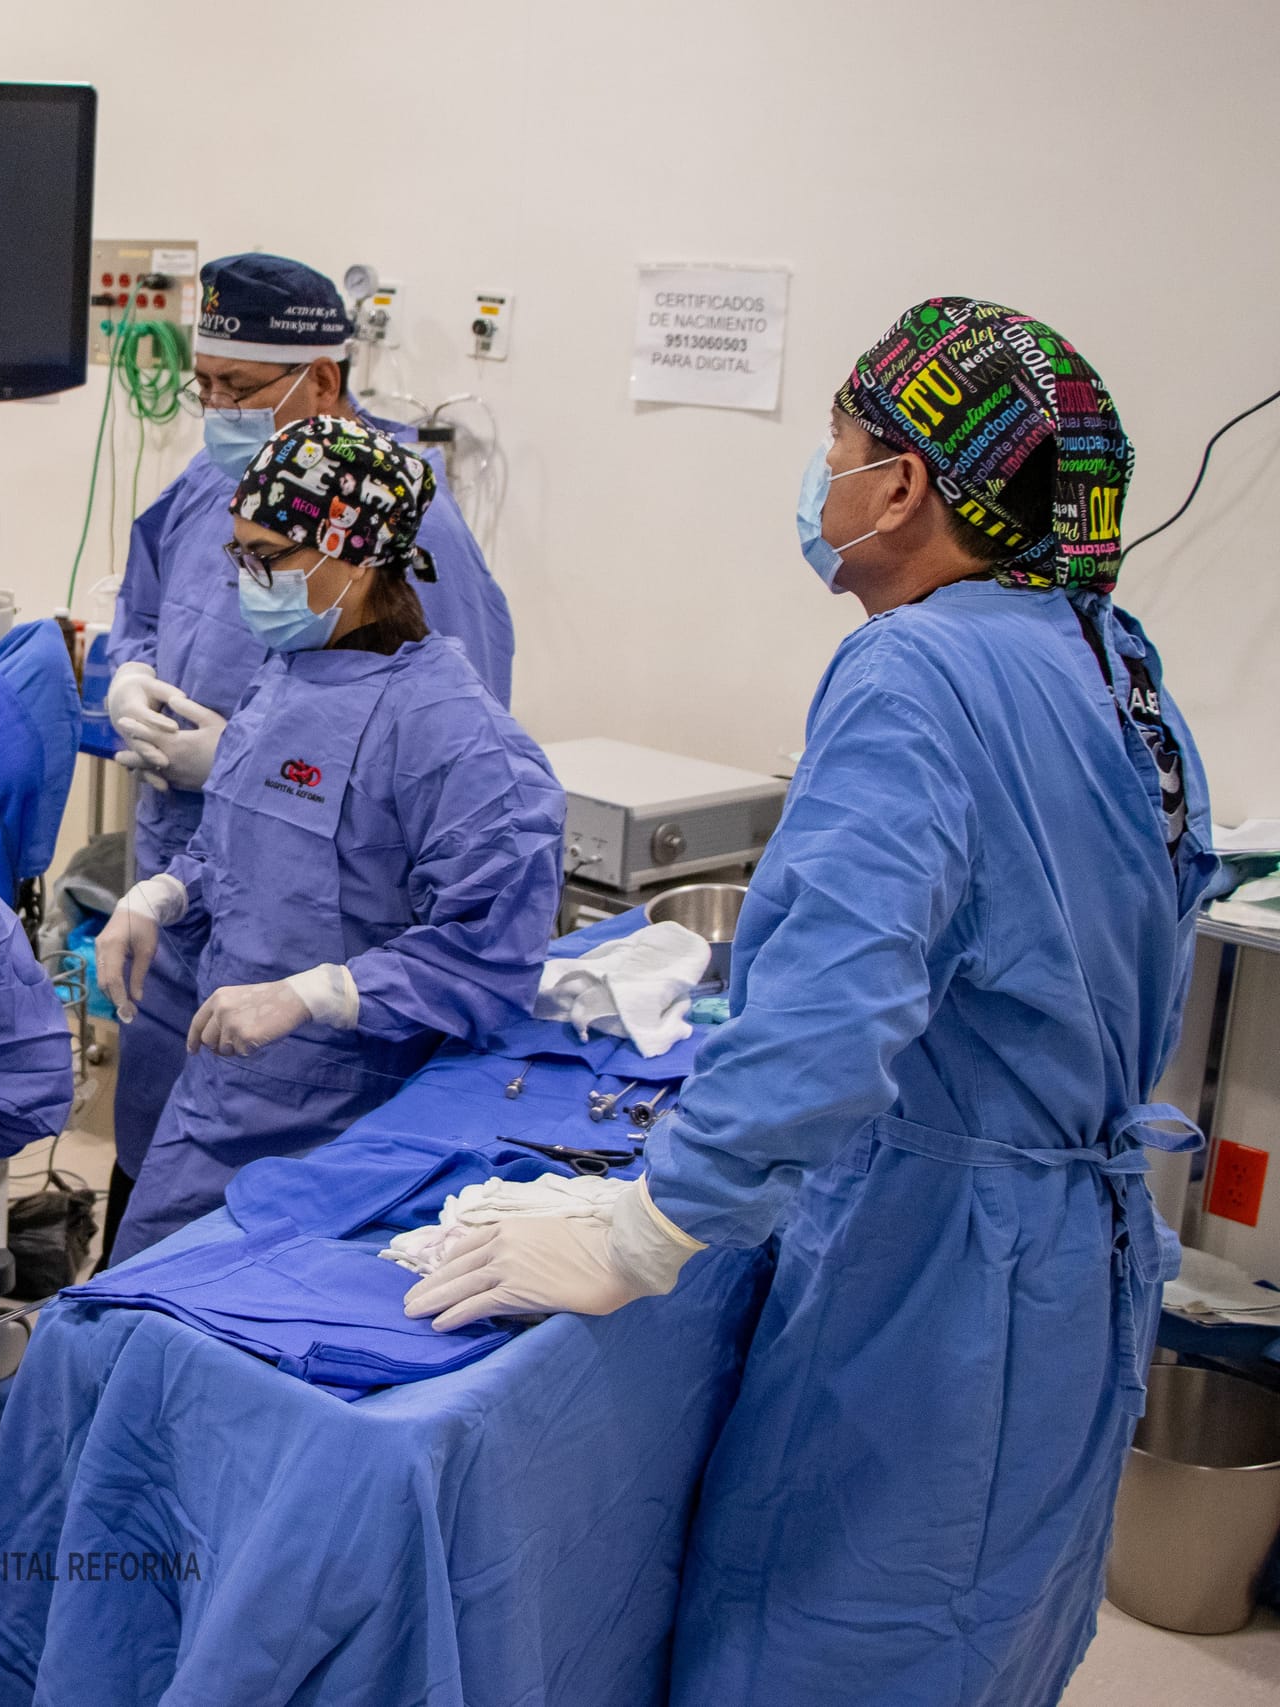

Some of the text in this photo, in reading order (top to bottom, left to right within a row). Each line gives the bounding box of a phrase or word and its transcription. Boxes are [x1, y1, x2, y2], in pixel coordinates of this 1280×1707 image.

[655, 292, 765, 312] CERTIFICADOS
[649, 312, 768, 333] DE NACIMIENTO
[664, 333, 748, 352] 9513060503
[651, 352, 756, 374] PARA DIGITAL
[274, 438, 298, 465] MEOW
[291, 496, 321, 520] MEOW
